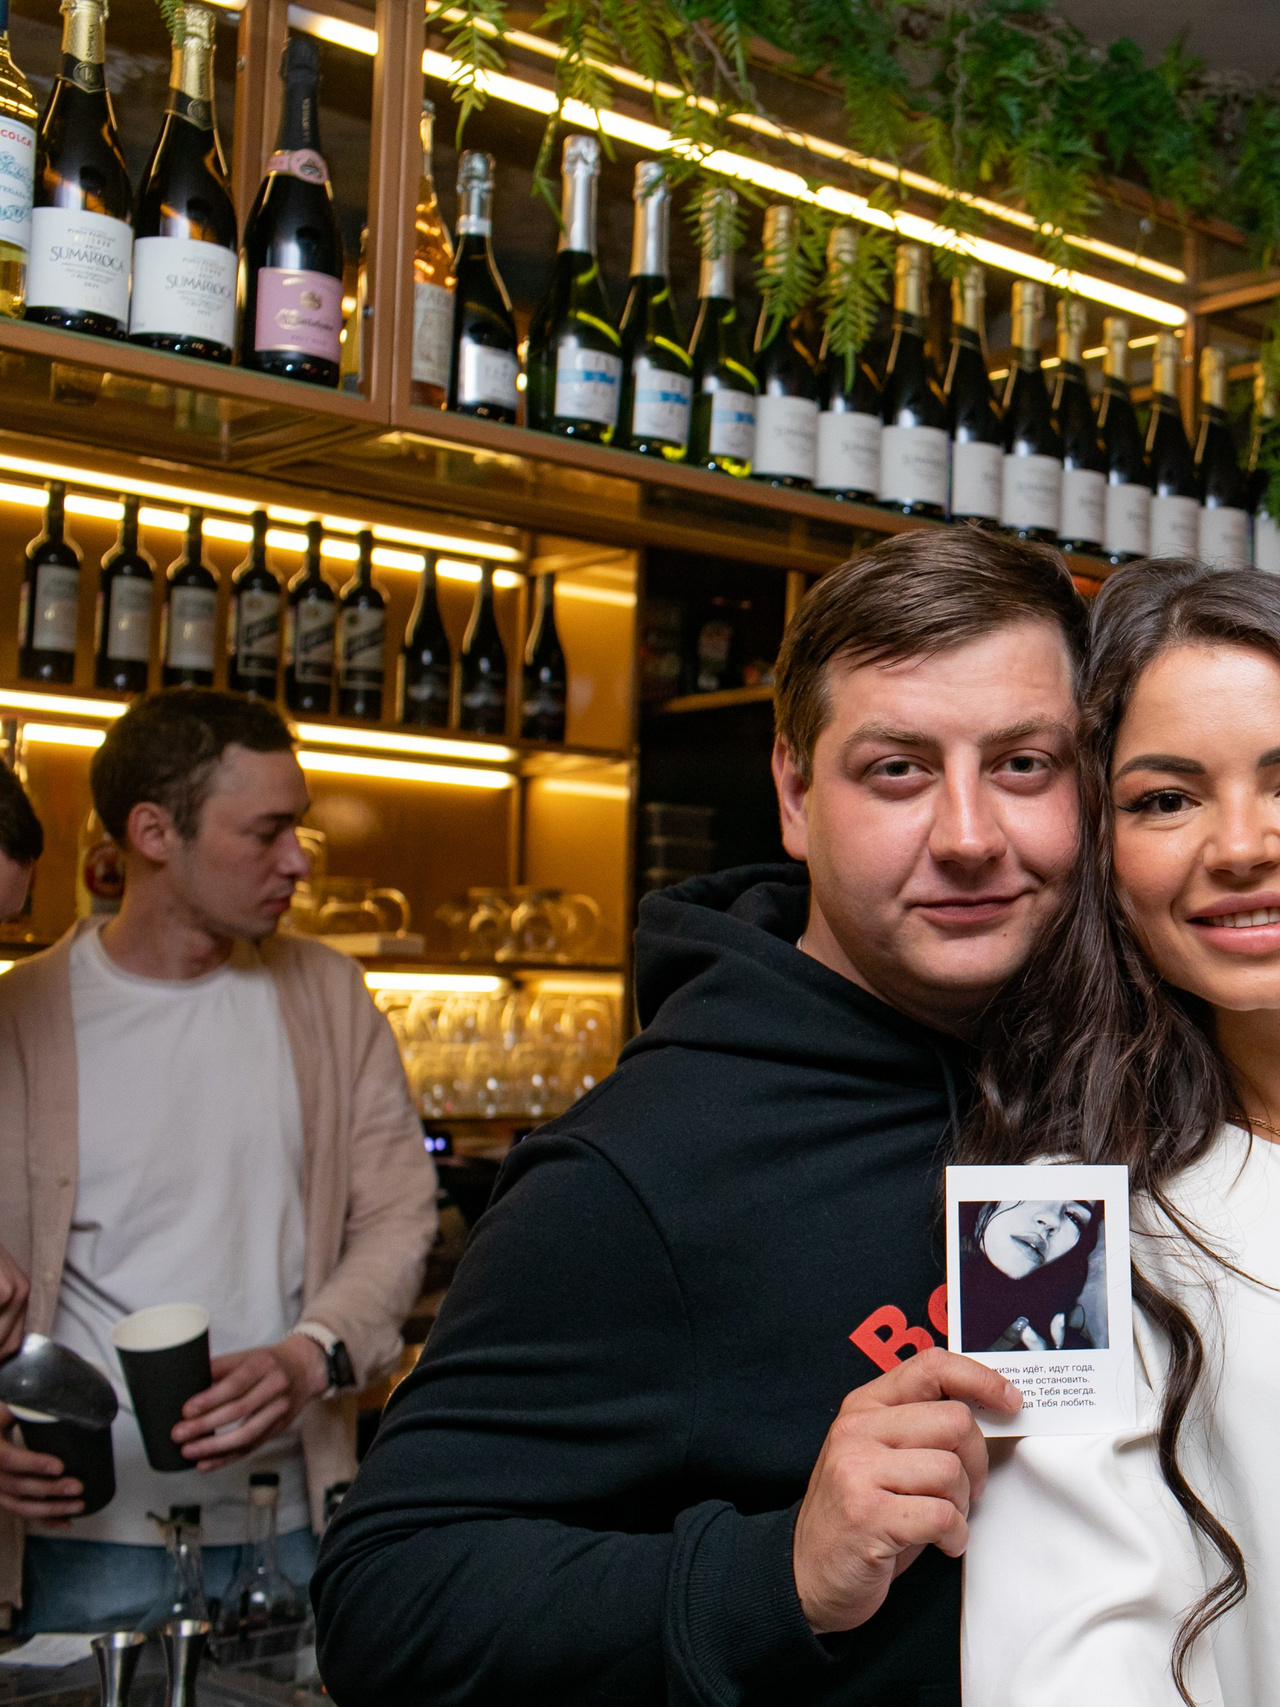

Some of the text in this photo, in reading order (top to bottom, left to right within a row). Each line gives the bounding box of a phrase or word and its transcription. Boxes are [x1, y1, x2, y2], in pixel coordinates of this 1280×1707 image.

[1023, 1364, 1046, 1374] идёт,
[1049, 1364, 1069, 1374] идут
[1072, 1363, 1095, 1373] года,
[1035, 1376, 1090, 1384] остановить.
[1039, 1386, 1061, 1396] Тебя
[1063, 1388, 1096, 1396] всегда.
[1036, 1398, 1058, 1408] Тебя
[1060, 1398, 1097, 1407] любить.
